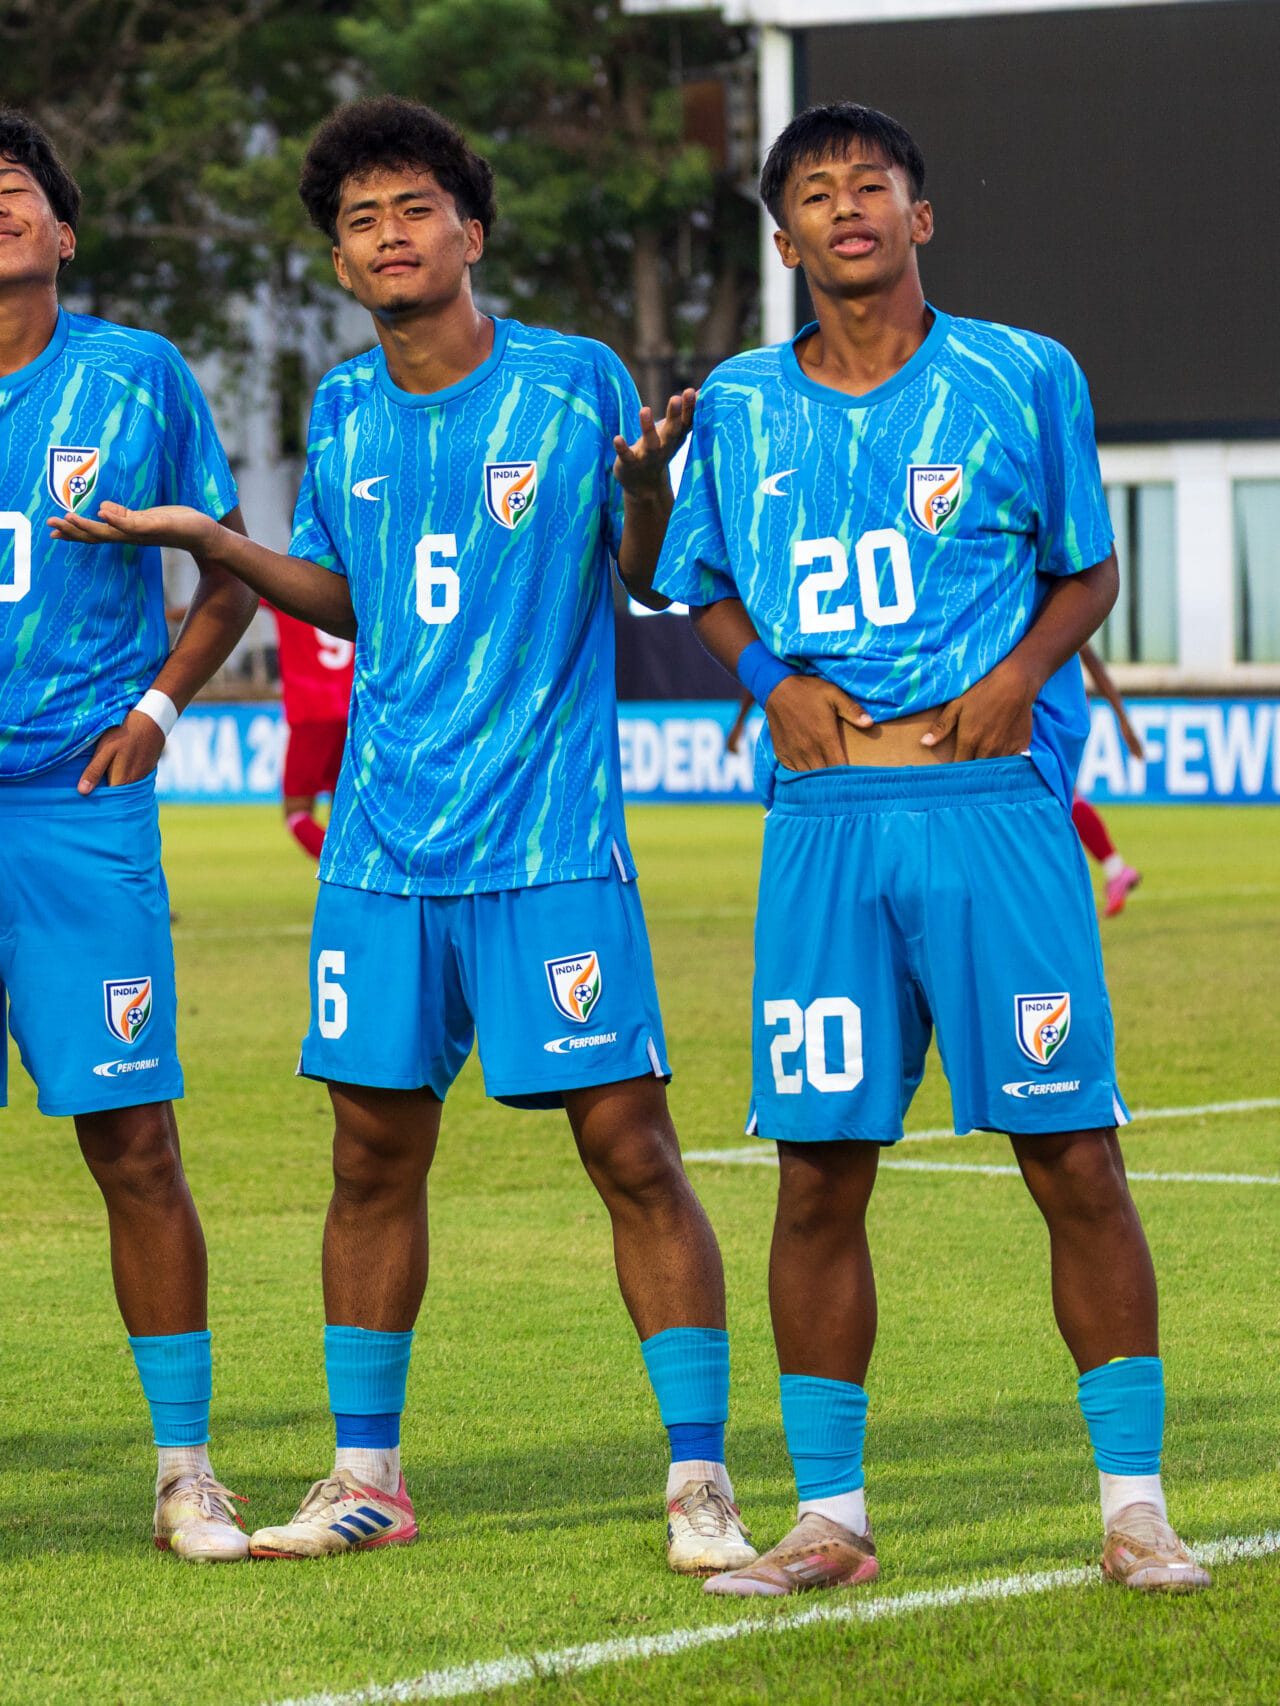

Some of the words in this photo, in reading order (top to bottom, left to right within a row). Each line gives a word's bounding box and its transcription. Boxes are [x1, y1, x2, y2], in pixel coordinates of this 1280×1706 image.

[56, 454, 84, 463] INDIA
[493, 470, 520, 479] INDIA
[917, 473, 945, 482] INDIA
[415, 533, 461, 624] 6
[794, 528, 917, 634] 20
[556, 963, 583, 975] INDIA
[113, 987, 139, 996] INDIA
[317, 950, 348, 1039] 6
[1025, 1003, 1053, 1011] INDIA
[569, 1032, 617, 1050] PERFORMAX
[764, 997, 864, 1094] 20
[117, 1056, 160, 1073] PERFORMAX
[1028, 1080, 1080, 1095] PERFORMAX
